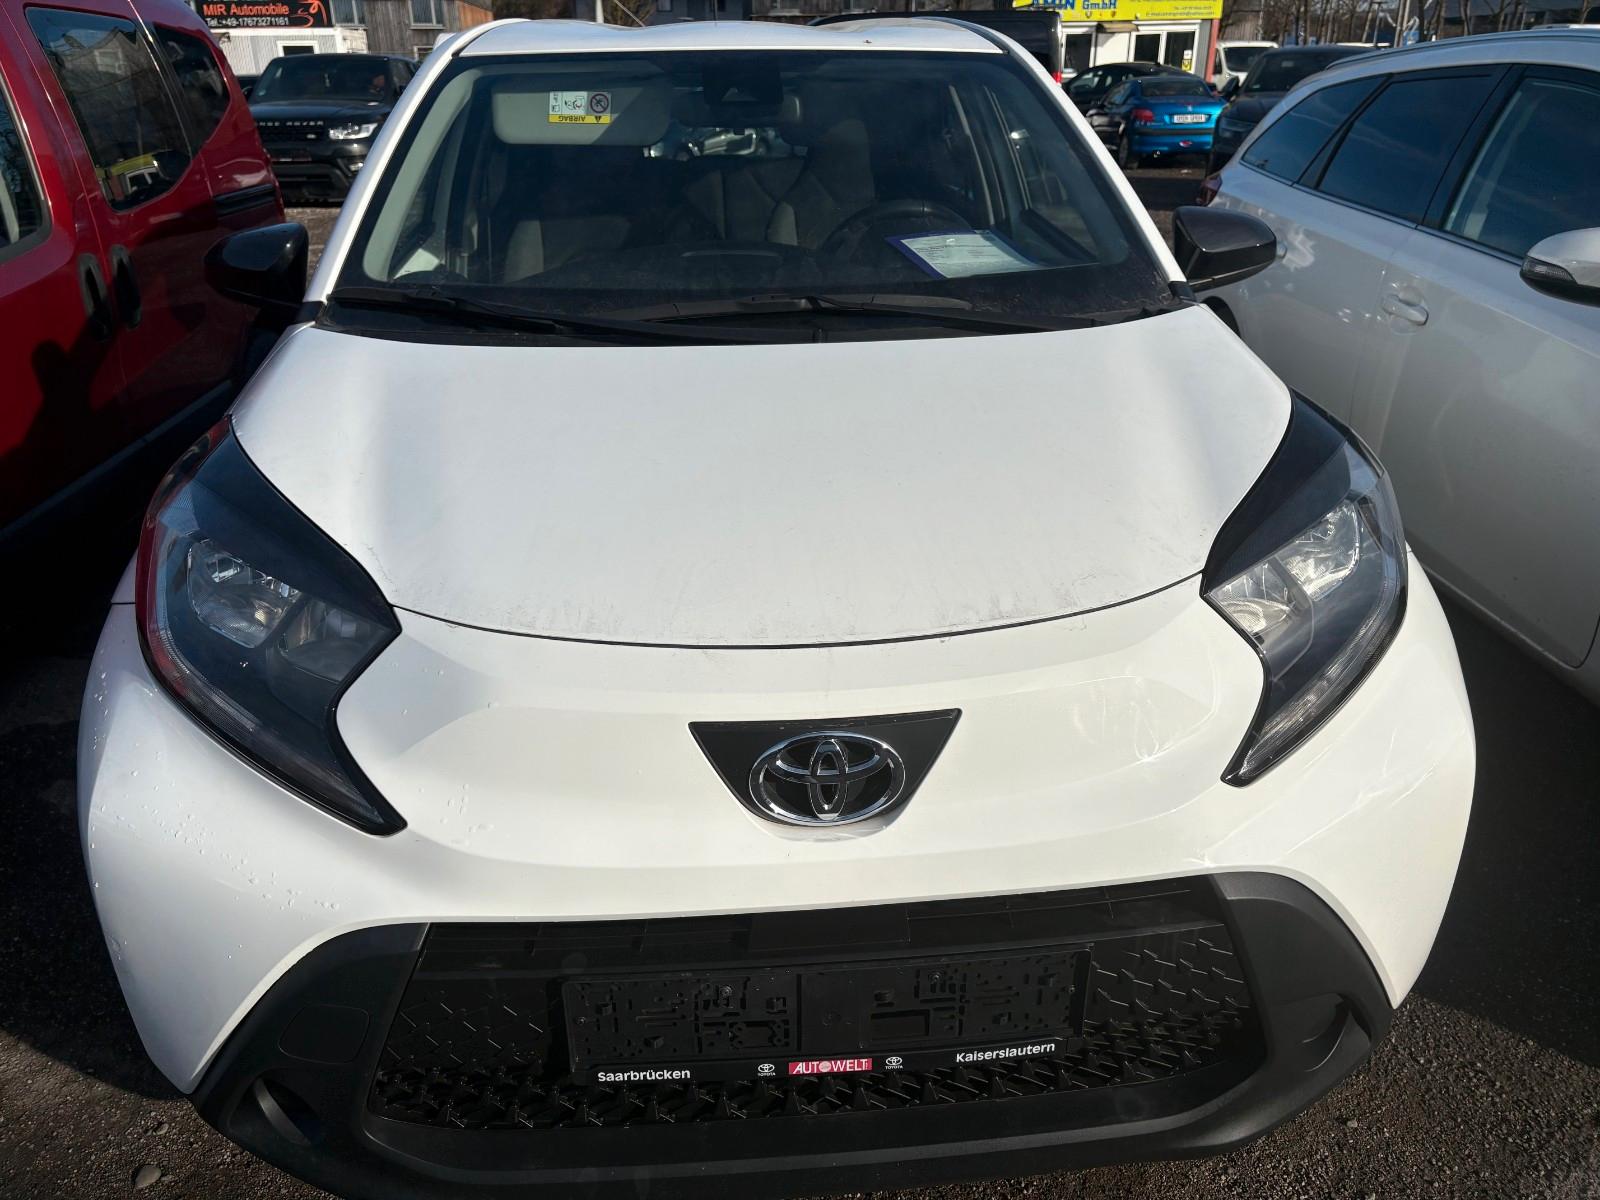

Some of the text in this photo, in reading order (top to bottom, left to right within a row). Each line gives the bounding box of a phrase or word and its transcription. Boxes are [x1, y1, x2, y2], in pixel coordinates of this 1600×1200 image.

[204, 3, 289, 15] MIR Automobile
[956, 1043, 1055, 1063] Kaiserslautern
[793, 1059, 867, 1074] AUTOWELT
[598, 1069, 691, 1082] Saarbrücken
